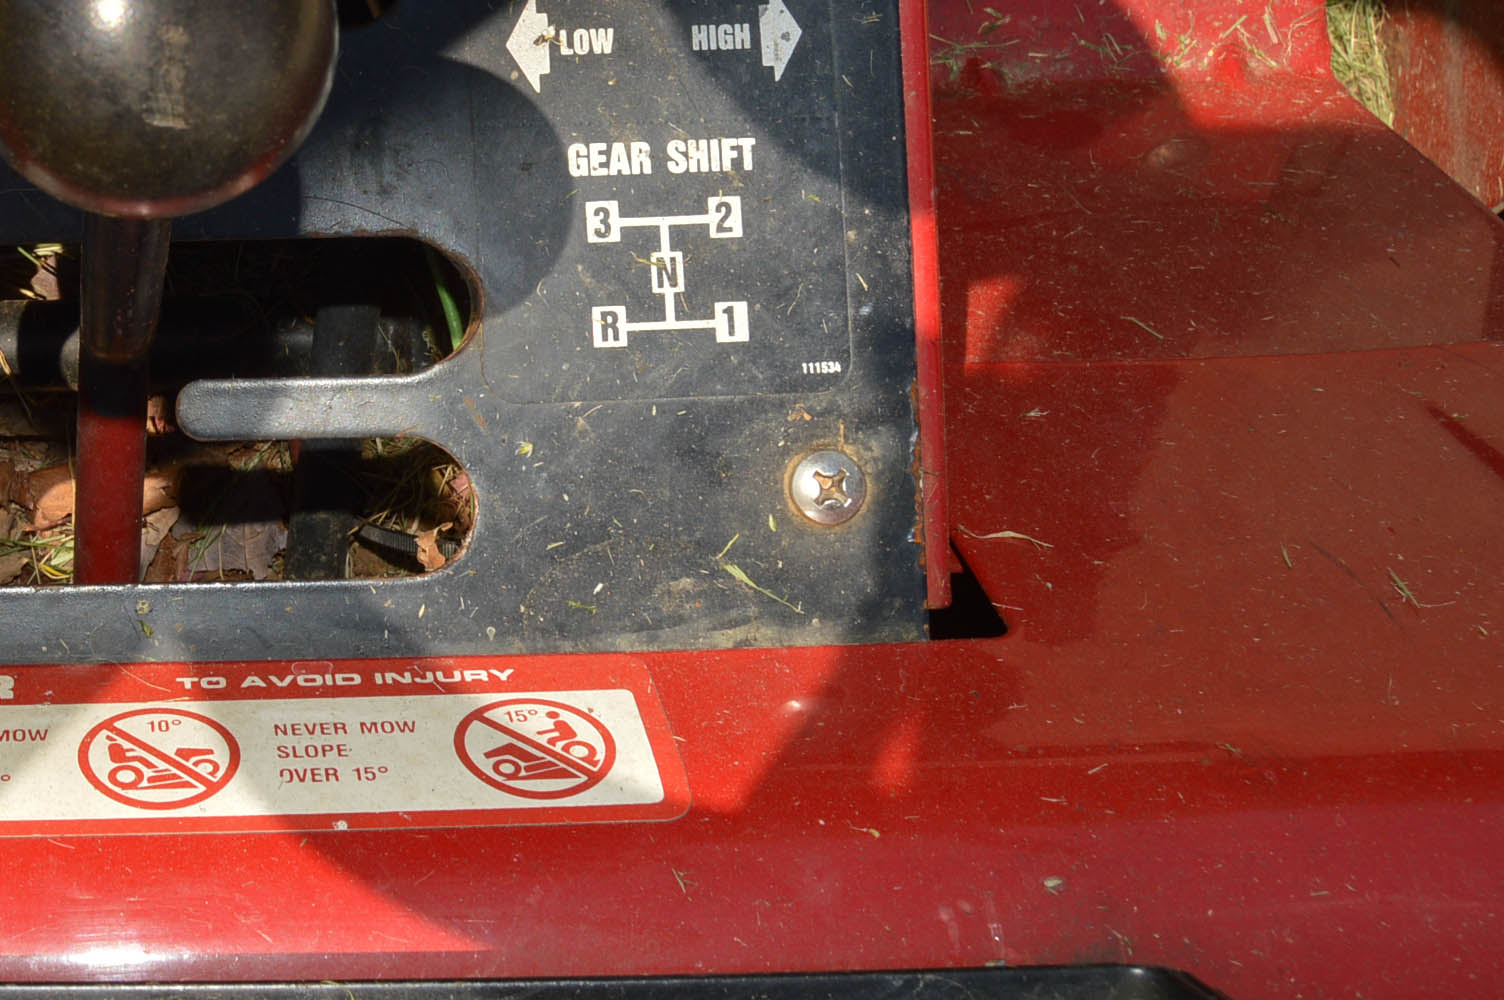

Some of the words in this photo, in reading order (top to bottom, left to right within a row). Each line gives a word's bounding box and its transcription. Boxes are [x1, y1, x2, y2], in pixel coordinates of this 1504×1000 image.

[559, 27, 614, 55] LOW
[692, 23, 752, 51] HIGH
[567, 140, 653, 178] GEAR
[666, 136, 756, 175] SHIFT
[594, 206, 612, 239] 3
[714, 201, 733, 233] 2
[656, 257, 679, 289] N
[599, 311, 621, 343] R
[801, 361, 842, 375] 111534
[176, 676, 226, 690] TO
[240, 672, 362, 688] AVOID
[374, 668, 515, 686] INJURY
[146, 718, 182, 734] 10°
[274, 721, 348, 738] NEVER
[360, 719, 416, 735] MOW
[504, 709, 539, 725] 15°
[276, 743, 350, 759] SLOPE
[279, 767, 340, 784] OVER
[352, 765, 389, 783] 15°
